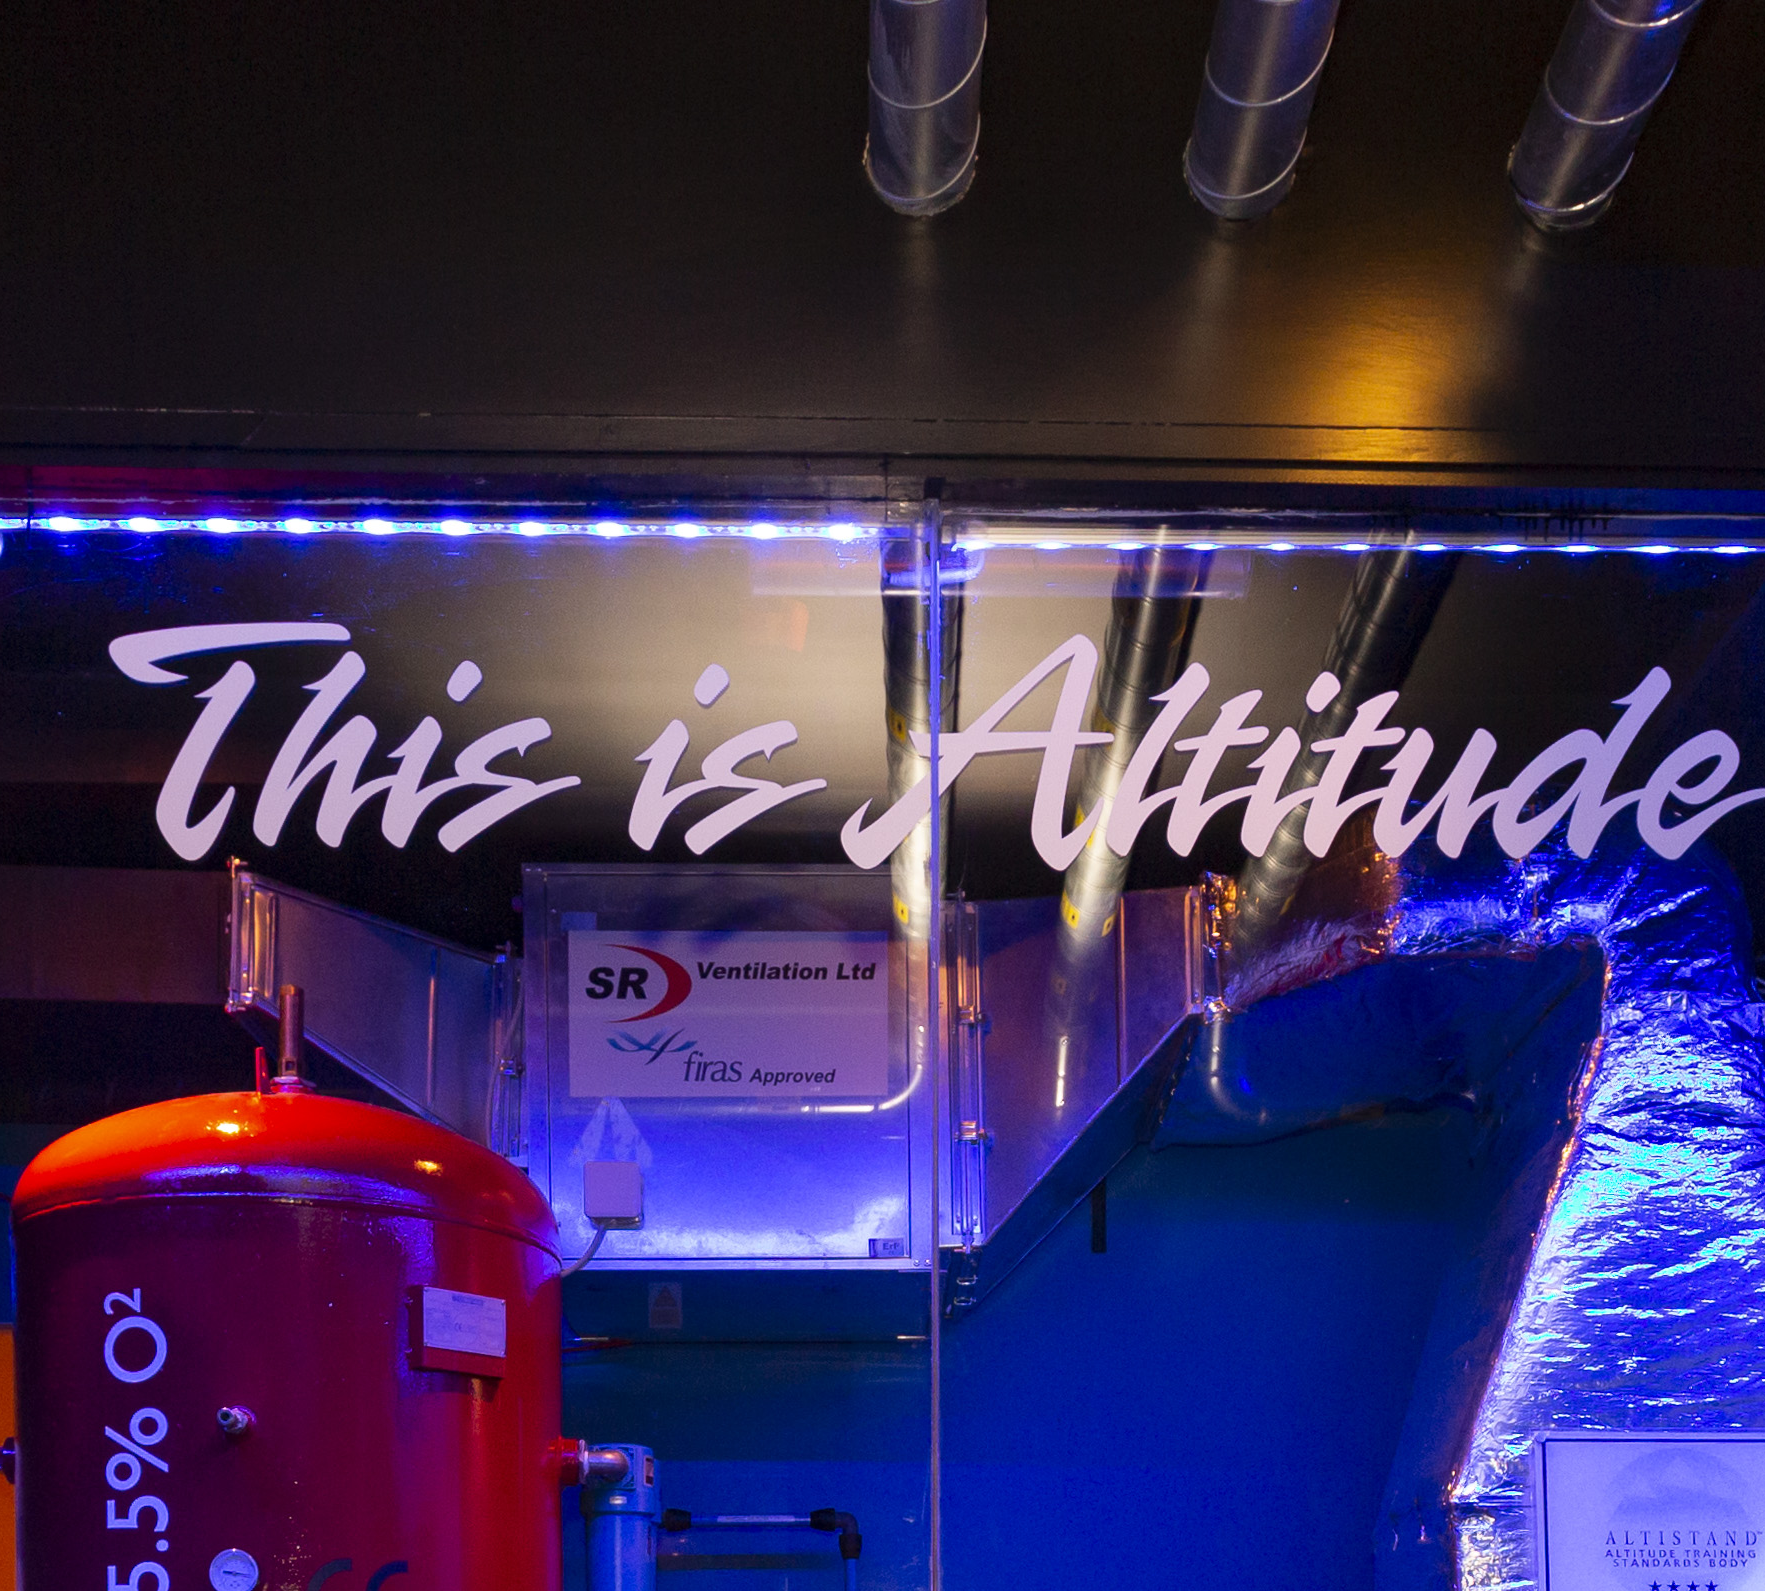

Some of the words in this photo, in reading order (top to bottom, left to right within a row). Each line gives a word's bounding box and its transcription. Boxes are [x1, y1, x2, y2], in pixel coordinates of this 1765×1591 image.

[109, 622, 581, 861] This
[628, 663, 827, 855] is
[585, 967, 648, 1000] SR
[697, 961, 828, 981] Ventilation
[836, 962, 876, 981] Ltd
[683, 1051, 742, 1083] firas
[749, 1068, 836, 1086] Approved
[1605, 1549, 1676, 1558] ALTITUDE
[1685, 1549, 1756, 1558] TRAINING
[1613, 1559, 1700, 1568] STANDARDS
[1709, 1559, 1749, 1568] BODY
